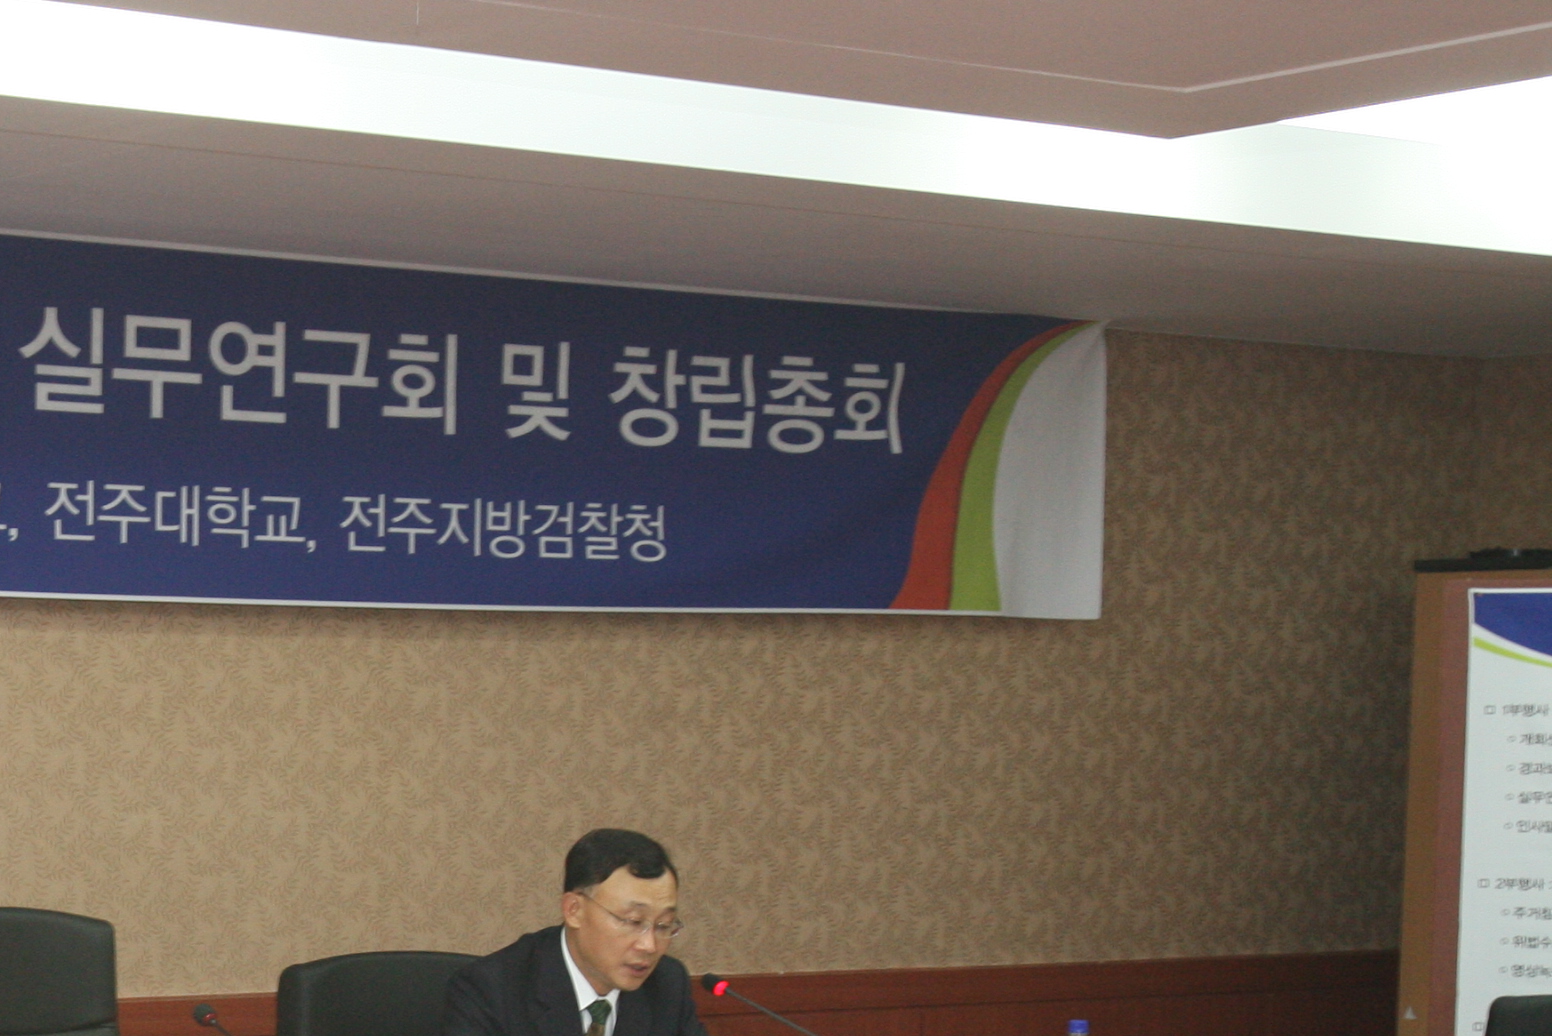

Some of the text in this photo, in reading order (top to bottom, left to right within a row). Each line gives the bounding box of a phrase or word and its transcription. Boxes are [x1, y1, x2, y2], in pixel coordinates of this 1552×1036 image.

[18, 306, 458, 436] 실무연구회
[501, 340, 571, 441] 및
[609, 345, 906, 455] 창립총회
[44, 479, 317, 553] 전주대학교,
[339, 493, 667, 563] 전주지방검찰청
